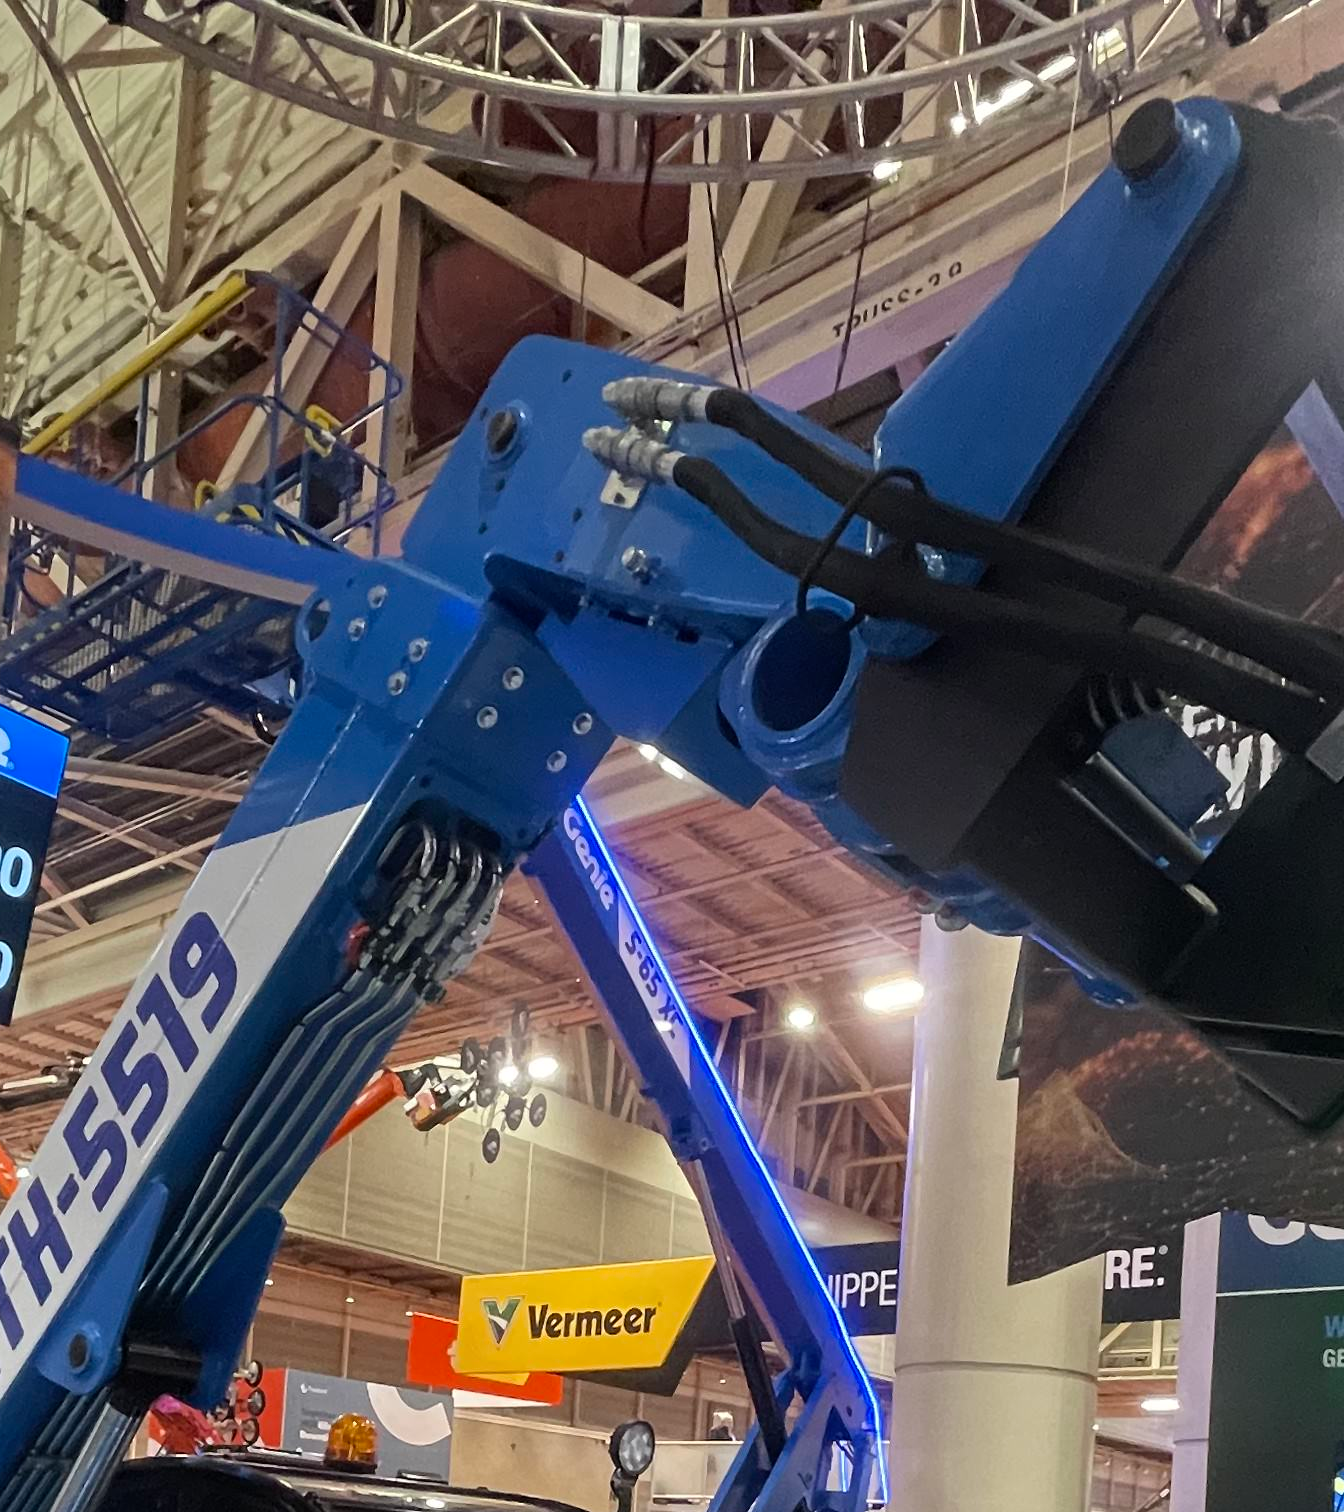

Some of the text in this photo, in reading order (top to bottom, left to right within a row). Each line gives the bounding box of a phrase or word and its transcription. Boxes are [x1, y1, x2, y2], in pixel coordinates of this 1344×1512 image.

[563, 807, 614, 911] Genie
[625, 930, 663, 998] S-65
[528, 1303, 656, 1338] Vermeer
